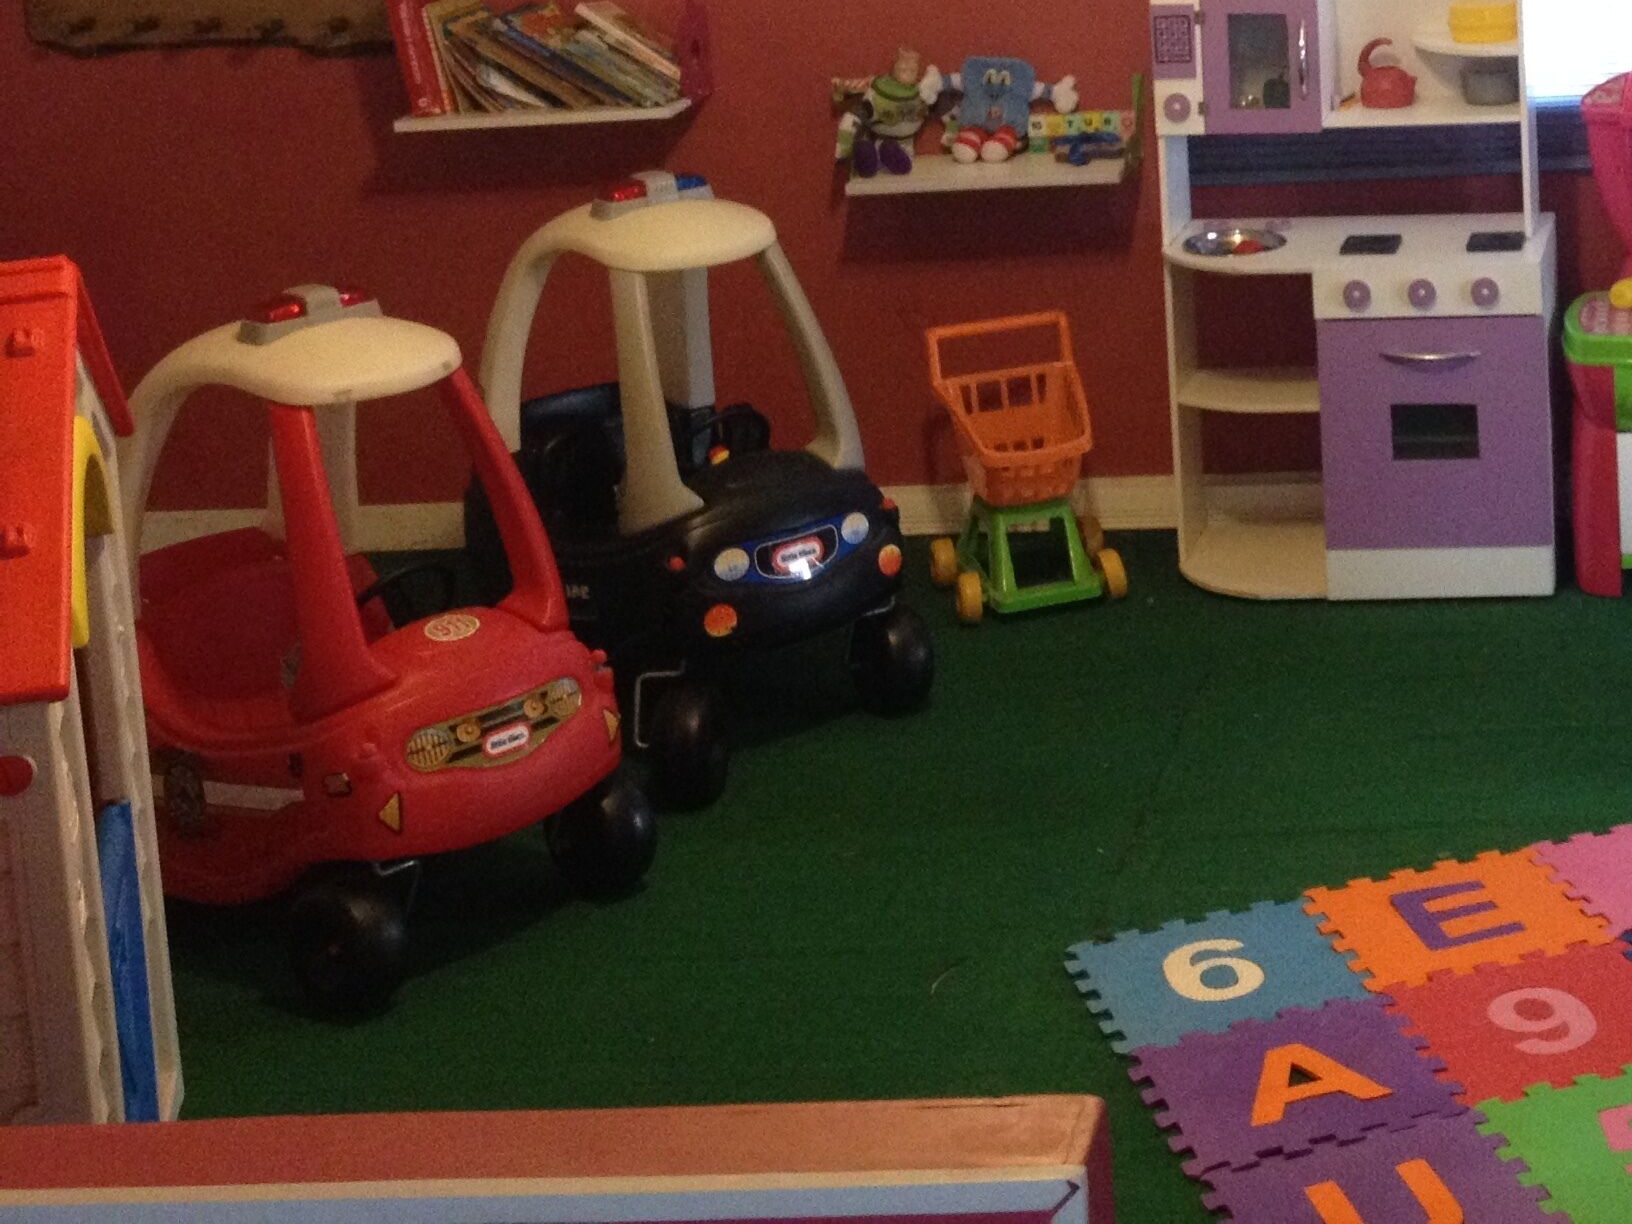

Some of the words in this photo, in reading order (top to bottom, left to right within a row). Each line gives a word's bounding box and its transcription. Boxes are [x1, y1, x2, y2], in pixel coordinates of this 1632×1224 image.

[1391, 880, 1526, 951] E
[1162, 937, 1265, 1002] 6
[1487, 987, 1598, 1056] 9
[1250, 1043, 1393, 1127] A
